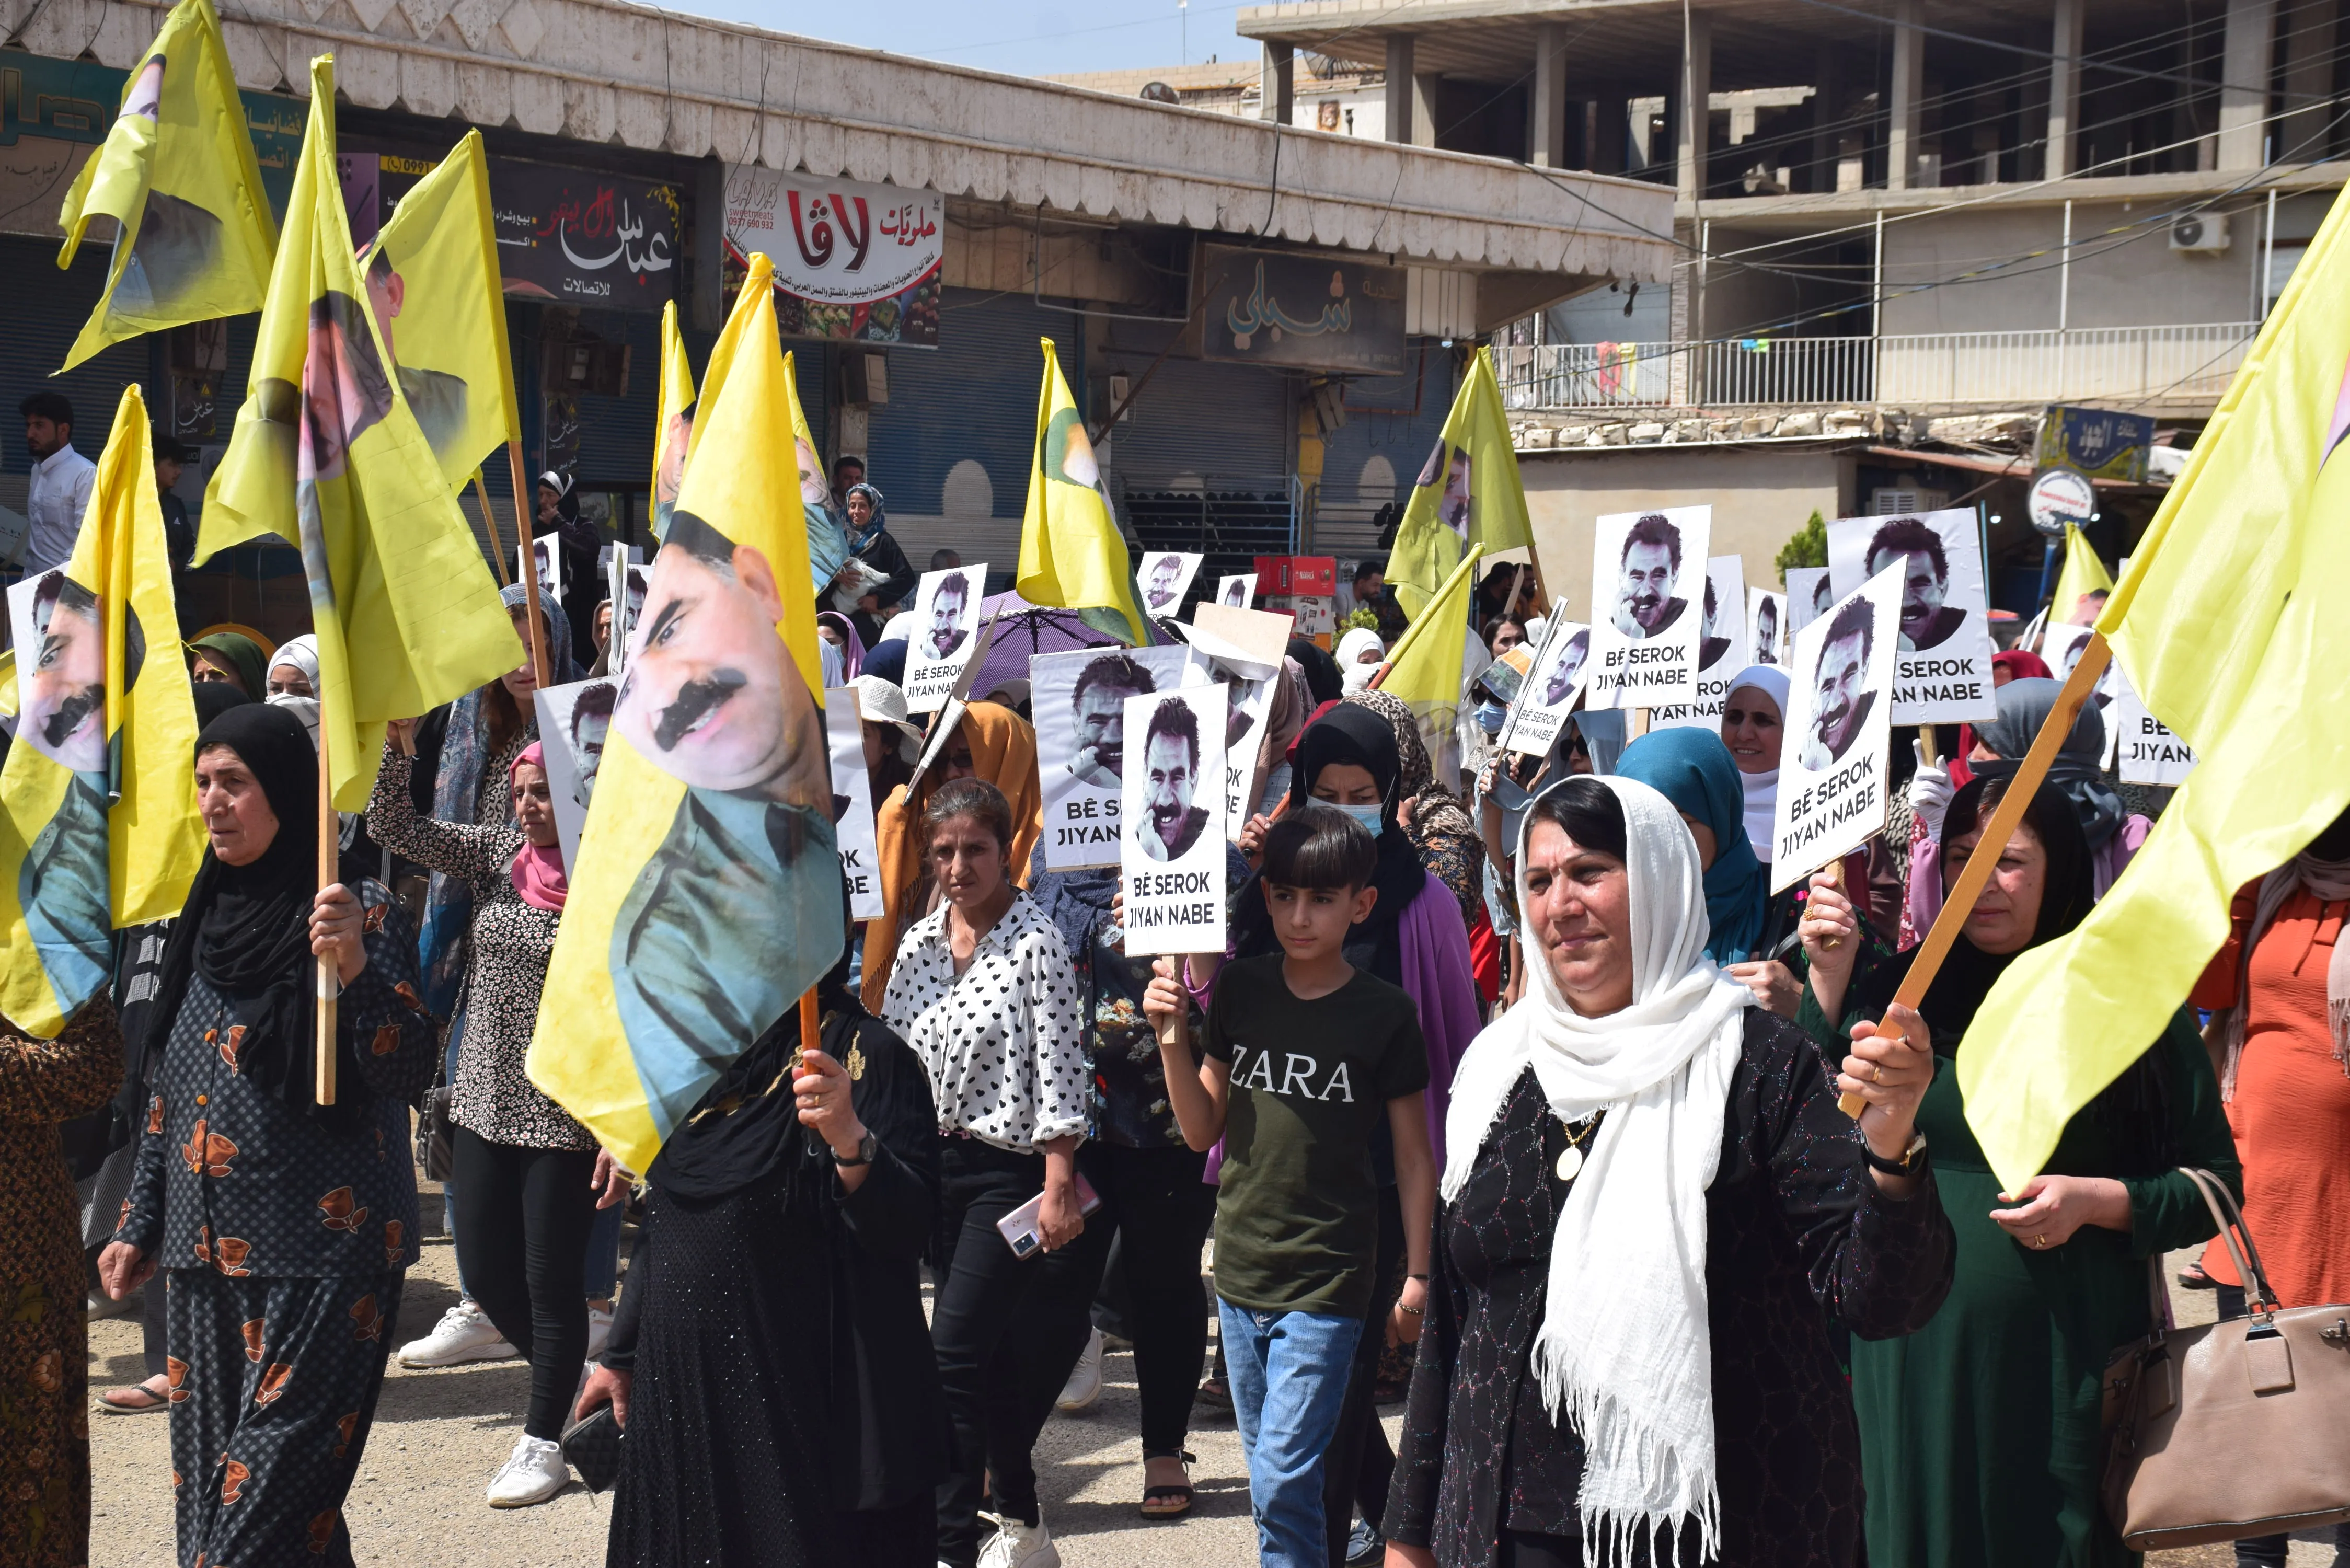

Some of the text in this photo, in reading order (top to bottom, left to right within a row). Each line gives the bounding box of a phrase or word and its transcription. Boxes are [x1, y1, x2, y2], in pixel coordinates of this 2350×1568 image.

[728, 177, 777, 210] LAVA
[729, 209, 774, 221] sweetmeats
[729, 217, 774, 230] 0937 690 932
[560, 197, 672, 287] عباس
[563, 277, 611, 296] للاتصالات
[1606, 645, 1686, 667] BÊ SEROK
[914, 664, 965, 681] BÊ SEROK
[1596, 668, 1688, 690] JIYAN NABE
[1899, 658, 1975, 679] SEROK
[907, 684, 935, 698] JIYAN
[1922, 683, 1983, 702] NABE
[1519, 708, 1560, 726] BÊ SEROK
[1651, 705, 1687, 721] YAN
[1514, 724, 1554, 741] YAN NABE
[2132, 742, 2191, 763] JIYAN
[1791, 752, 1874, 823] BÊ SEROK
[1066, 797, 1099, 820] BÊ
[1781, 781, 1876, 860] JIYAN NABE
[1057, 824, 1121, 846] JIYAN
[1133, 871, 1211, 897] BÊ SEROK
[1130, 903, 1214, 929] JIYAN NABE
[1230, 1044, 1355, 1102] ZARA
